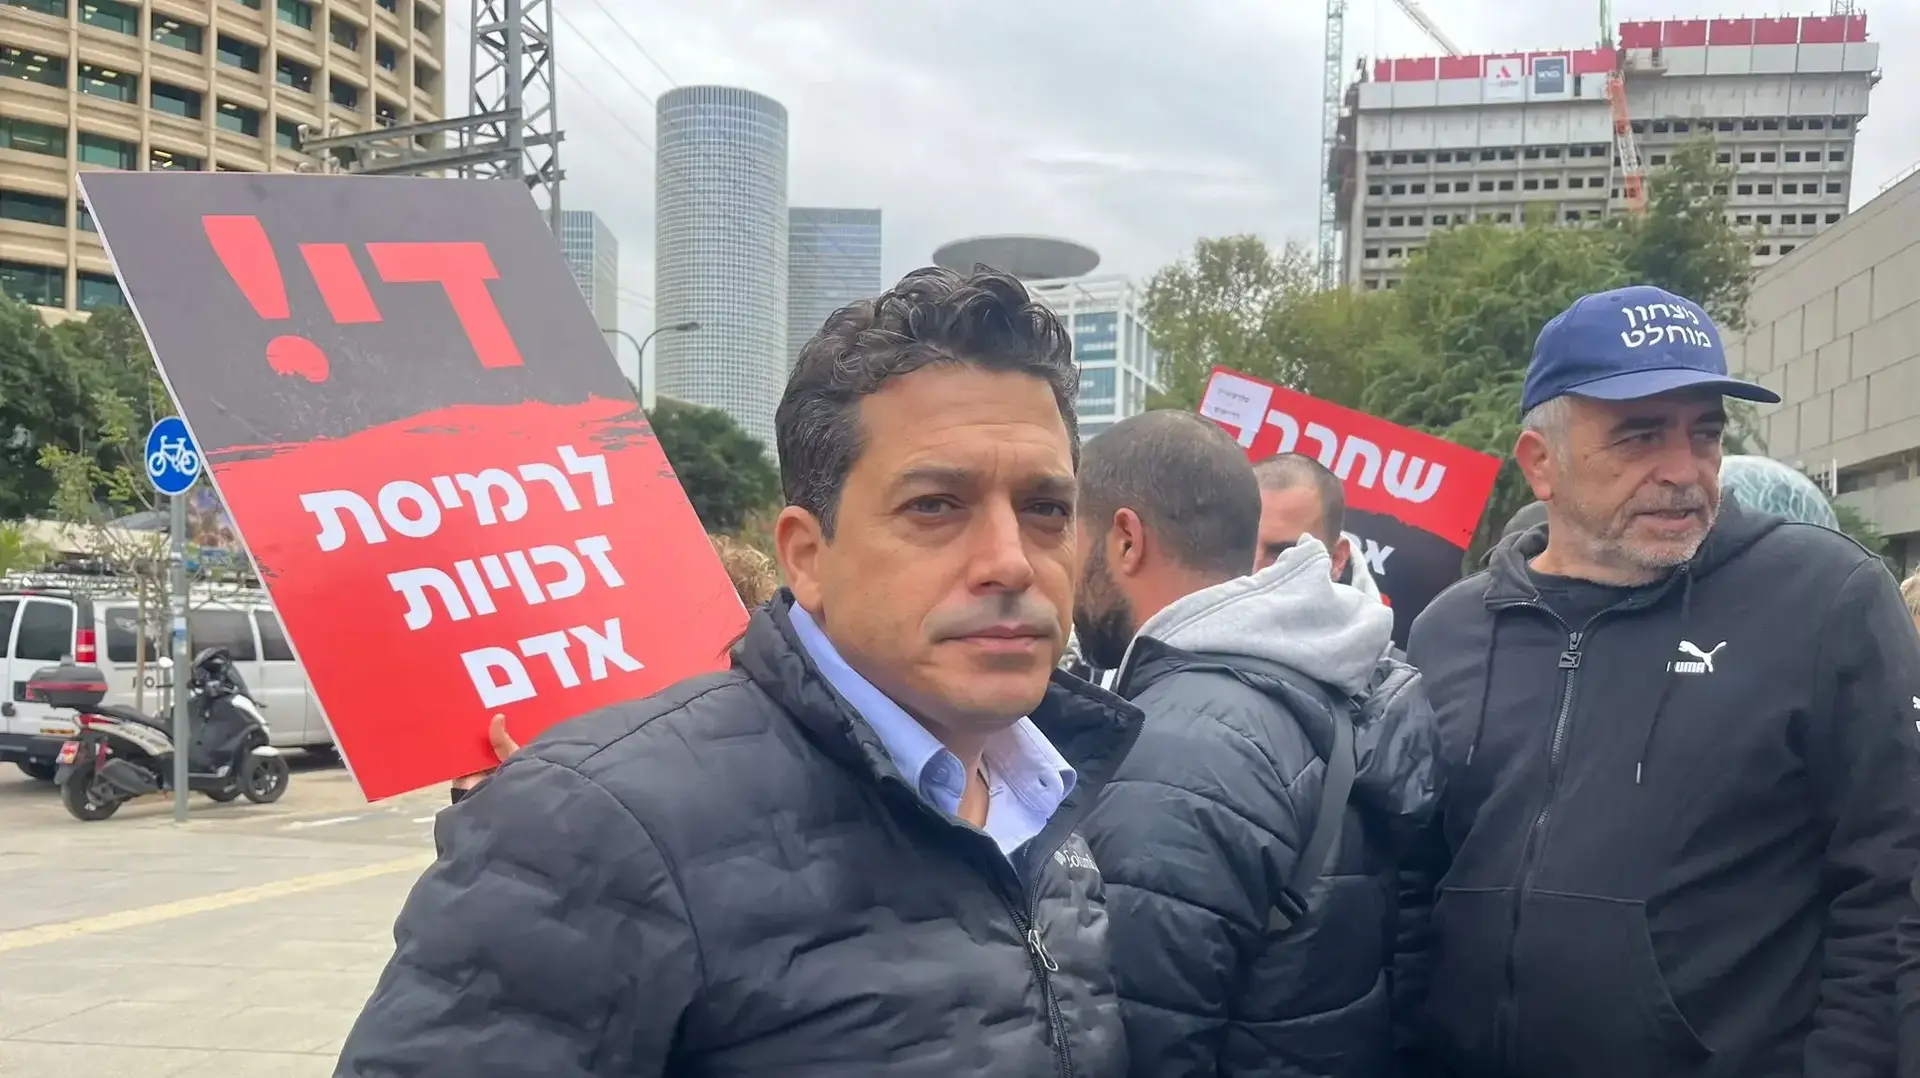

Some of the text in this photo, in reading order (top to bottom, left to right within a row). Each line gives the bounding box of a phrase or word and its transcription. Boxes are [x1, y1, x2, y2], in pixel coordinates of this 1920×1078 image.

[201, 214, 524, 383] די!
[1620, 324, 1712, 348] מוחלט
[299, 444, 614, 552] לרמיסת
[386, 534, 625, 631] זכויות
[459, 617, 645, 709] אדם
